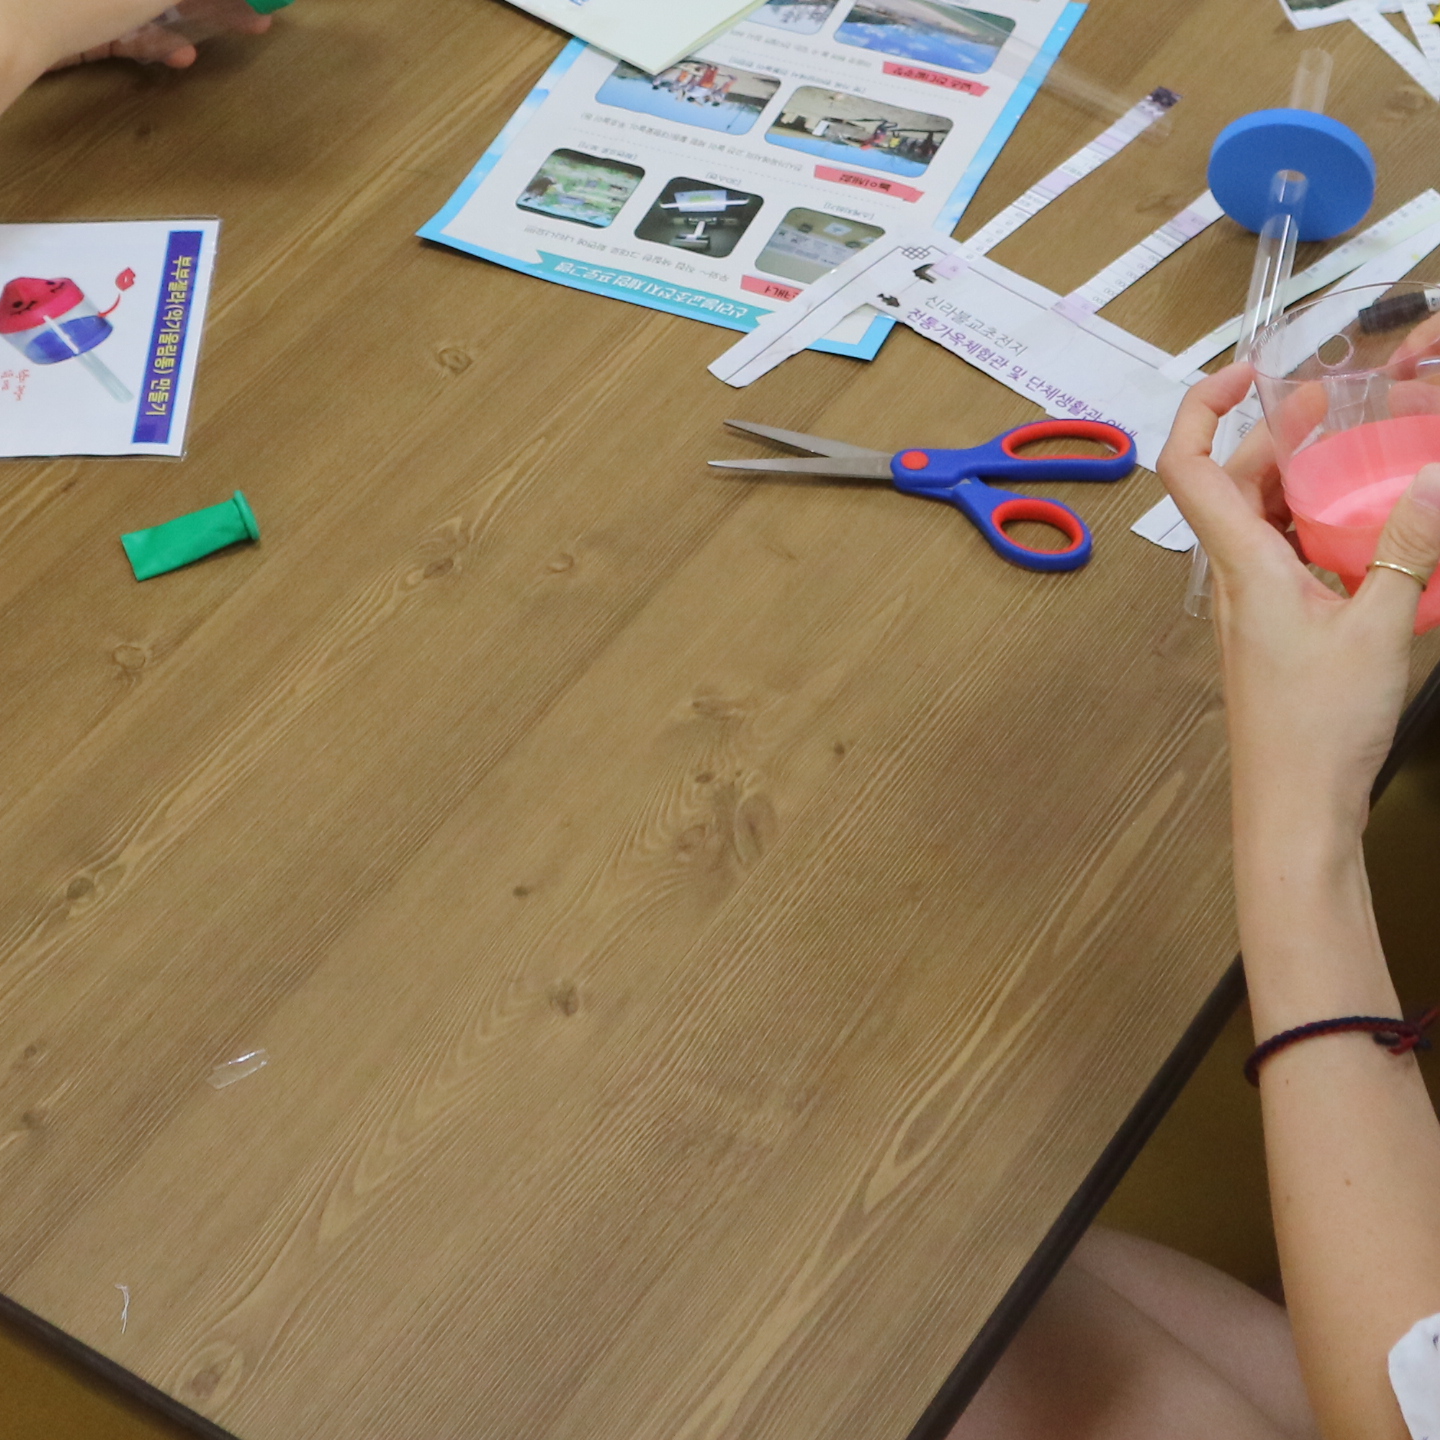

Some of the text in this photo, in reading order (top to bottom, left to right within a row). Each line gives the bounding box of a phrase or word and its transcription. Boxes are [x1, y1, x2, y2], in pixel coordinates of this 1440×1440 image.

[552, 258, 748, 319] 신라불교초전지 체험 프로그램
[762, 283, 797, 300] 캐너
[144, 254, 193, 416] 부부젤라(악기울림통) 만들기
[906, 306, 1011, 370] 전통가옥체험관
[1008, 361, 1028, 384] 및
[925, 294, 1028, 356] 신라불교초전지
